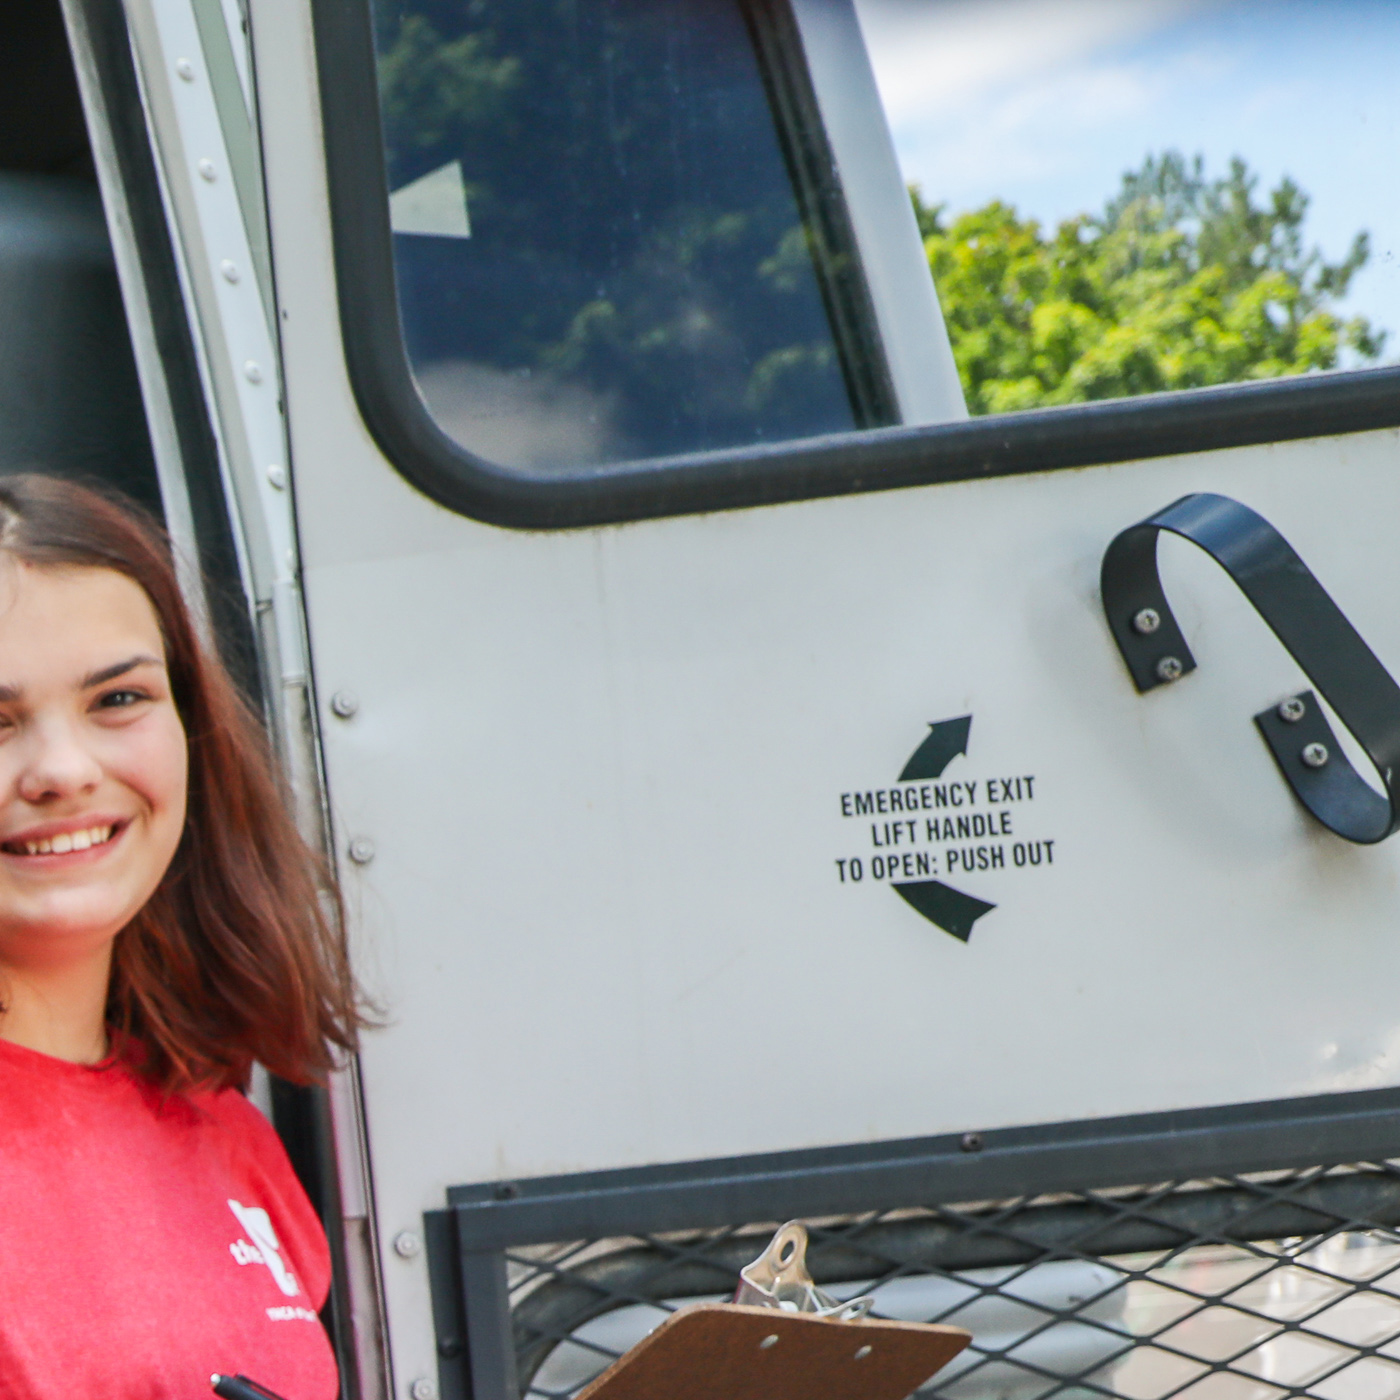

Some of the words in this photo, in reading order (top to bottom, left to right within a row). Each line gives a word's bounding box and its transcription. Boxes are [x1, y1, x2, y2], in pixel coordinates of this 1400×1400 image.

[840, 781, 977, 816] EMERGENCY
[987, 775, 1035, 803] EXIT
[872, 820, 917, 847] LIFT
[927, 811, 1012, 842] HANDLE
[836, 858, 863, 883] TO
[871, 851, 938, 880] OPEN:
[947, 846, 1005, 872] PUSH
[1013, 840, 1055, 867] OUT
